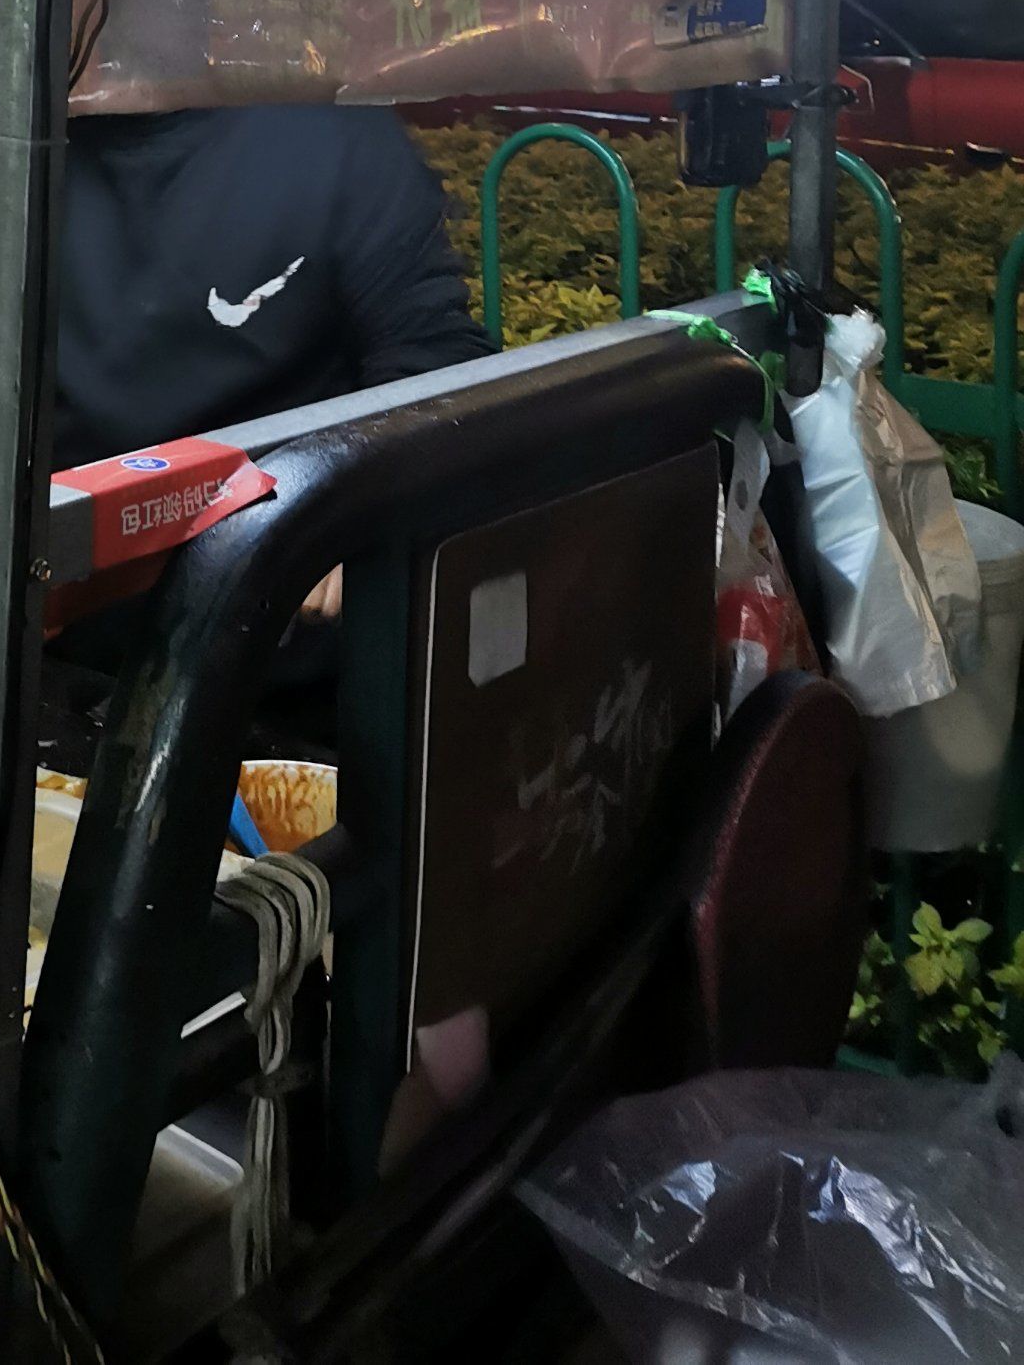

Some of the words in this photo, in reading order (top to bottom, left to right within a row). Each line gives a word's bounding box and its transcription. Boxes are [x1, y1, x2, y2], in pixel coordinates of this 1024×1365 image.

[121, 478, 233, 535] 扫码领红包
